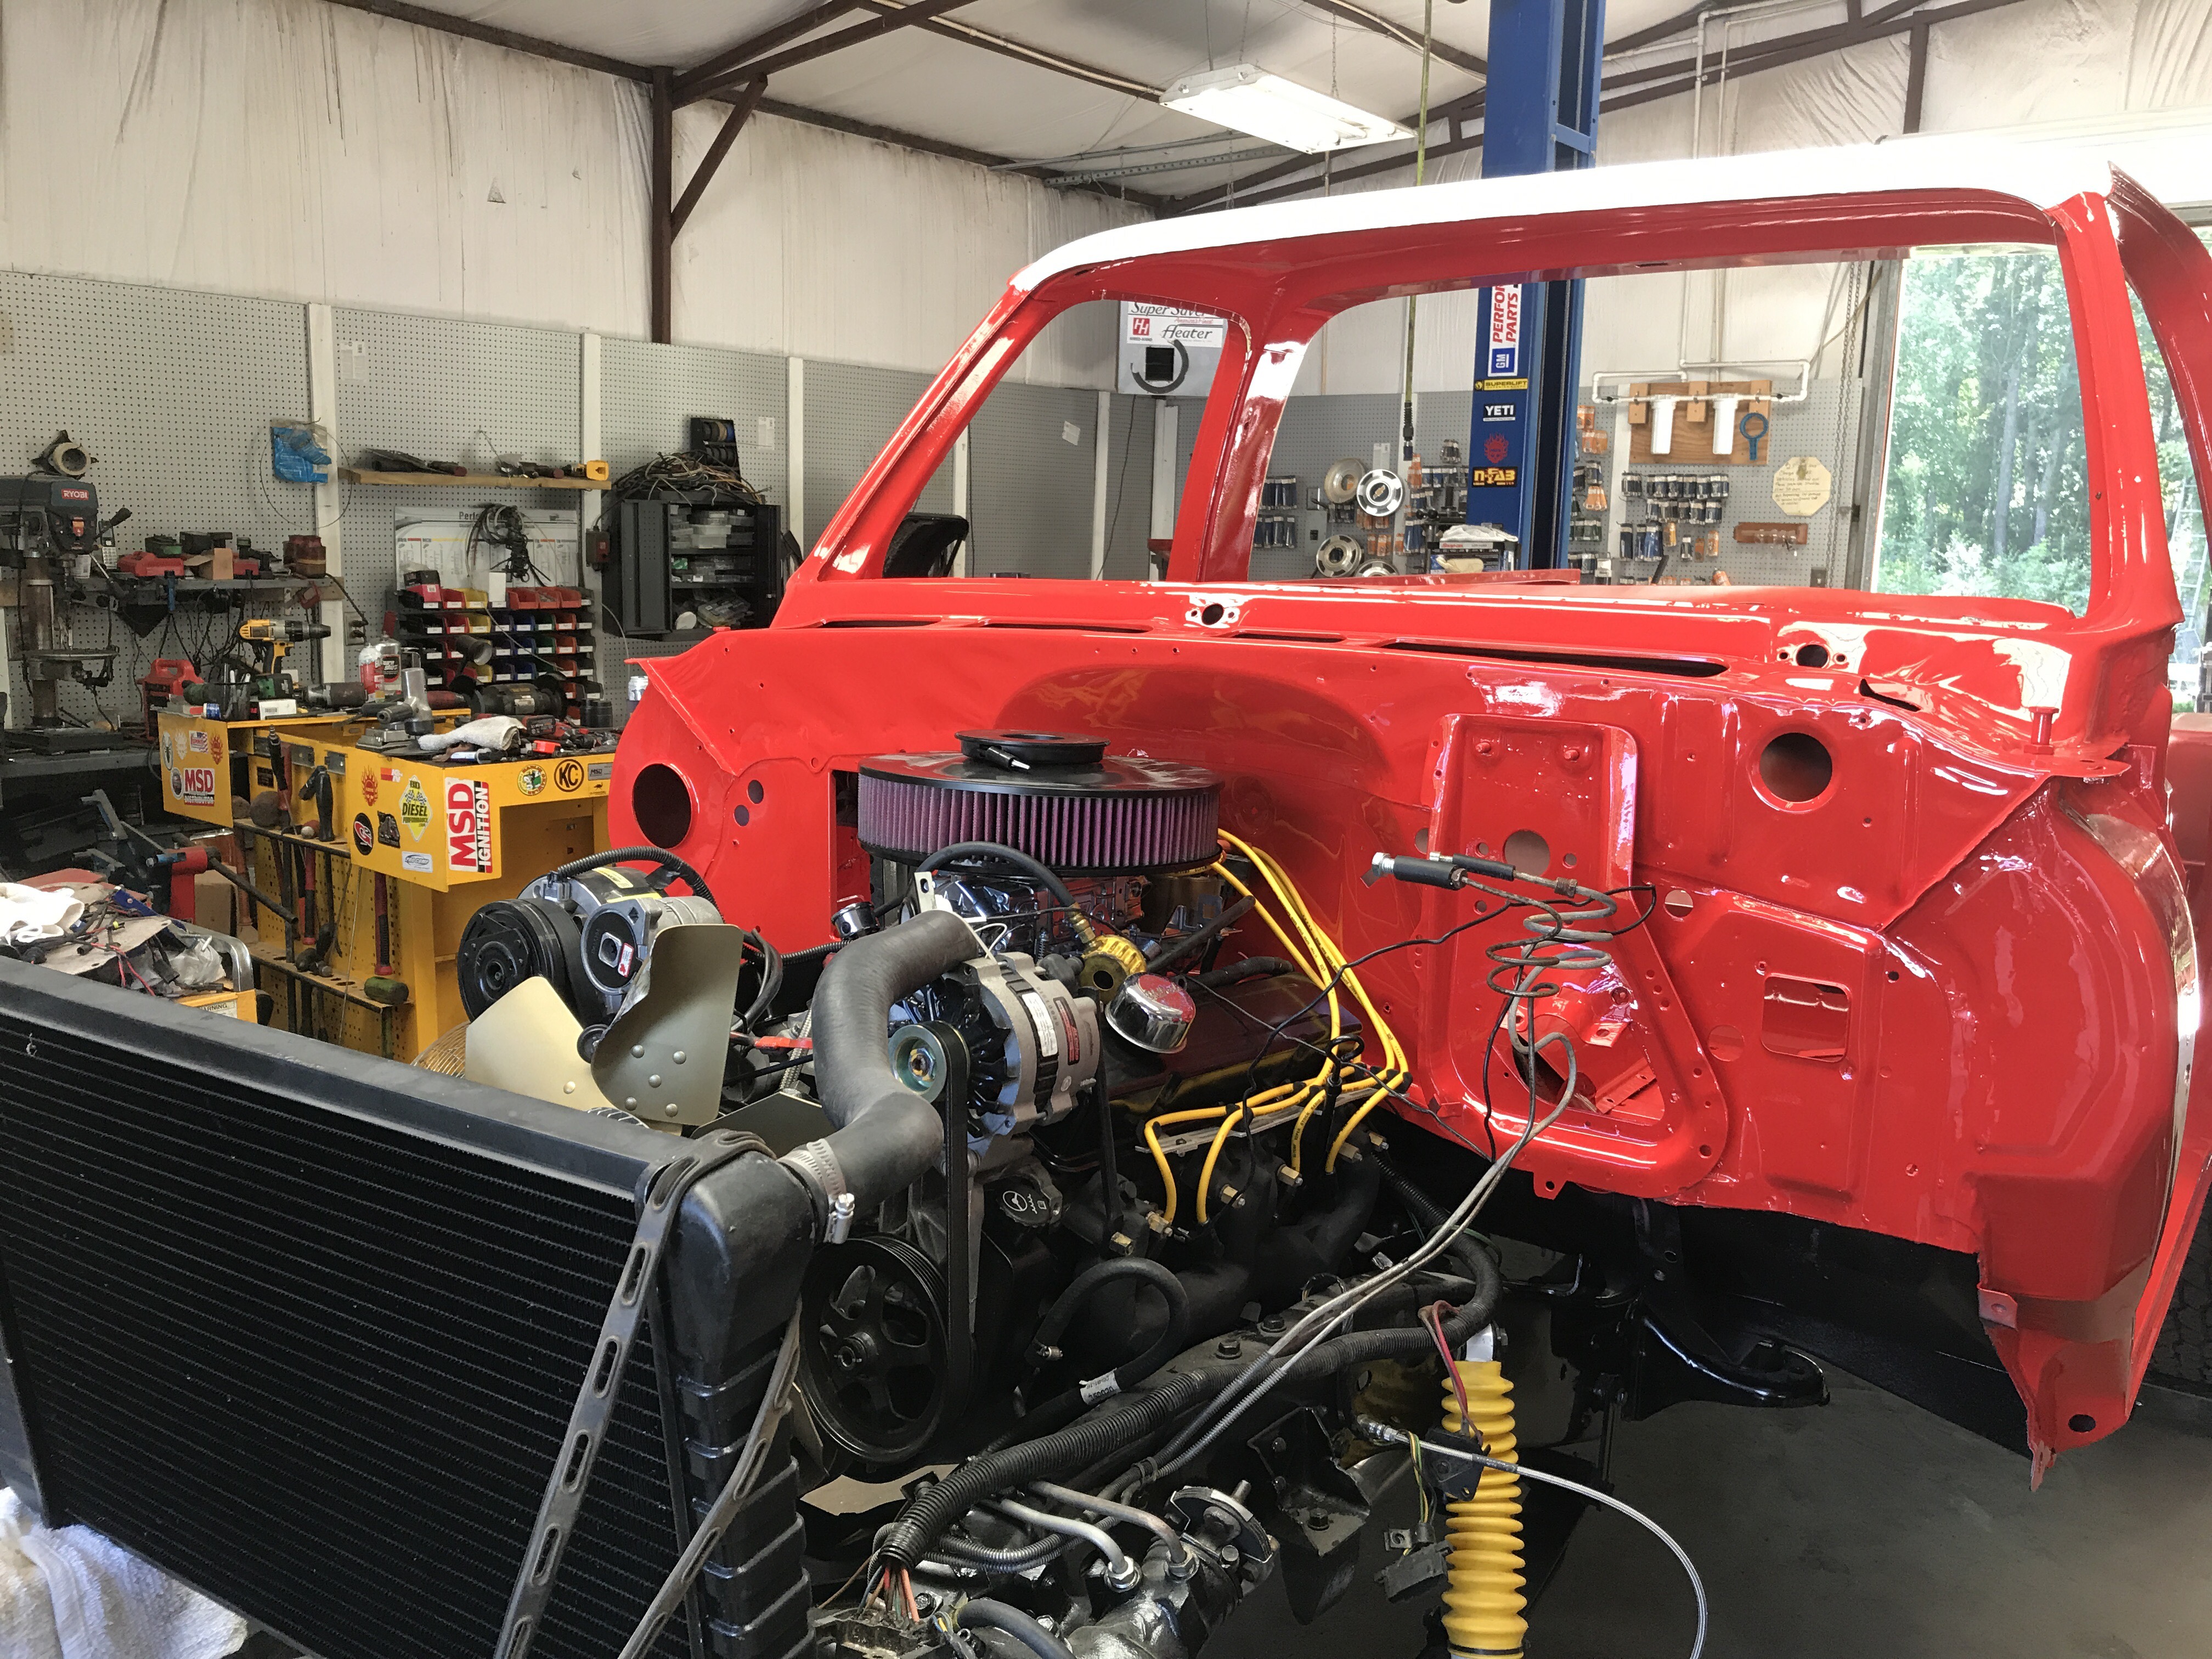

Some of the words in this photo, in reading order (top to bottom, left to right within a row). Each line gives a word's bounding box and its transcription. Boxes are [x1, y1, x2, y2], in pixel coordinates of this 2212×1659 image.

[1131, 302, 1169, 317] Super
[1506, 293, 1518, 342] PARTS
[1161, 324, 1212, 339] Heater
[1496, 354, 1505, 368] GM
[1485, 405, 1514, 416] YETI
[63, 490, 88, 499] RYOBI
[185, 769, 213, 793] MSD
[559, 763, 578, 788] KC
[410, 780, 420, 789] BD
[402, 802, 427, 816] DIESEL
[448, 783, 477, 866] MSD
[475, 787, 491, 866] IGNITION
[1300, 1112, 1310, 1125] STOCK
